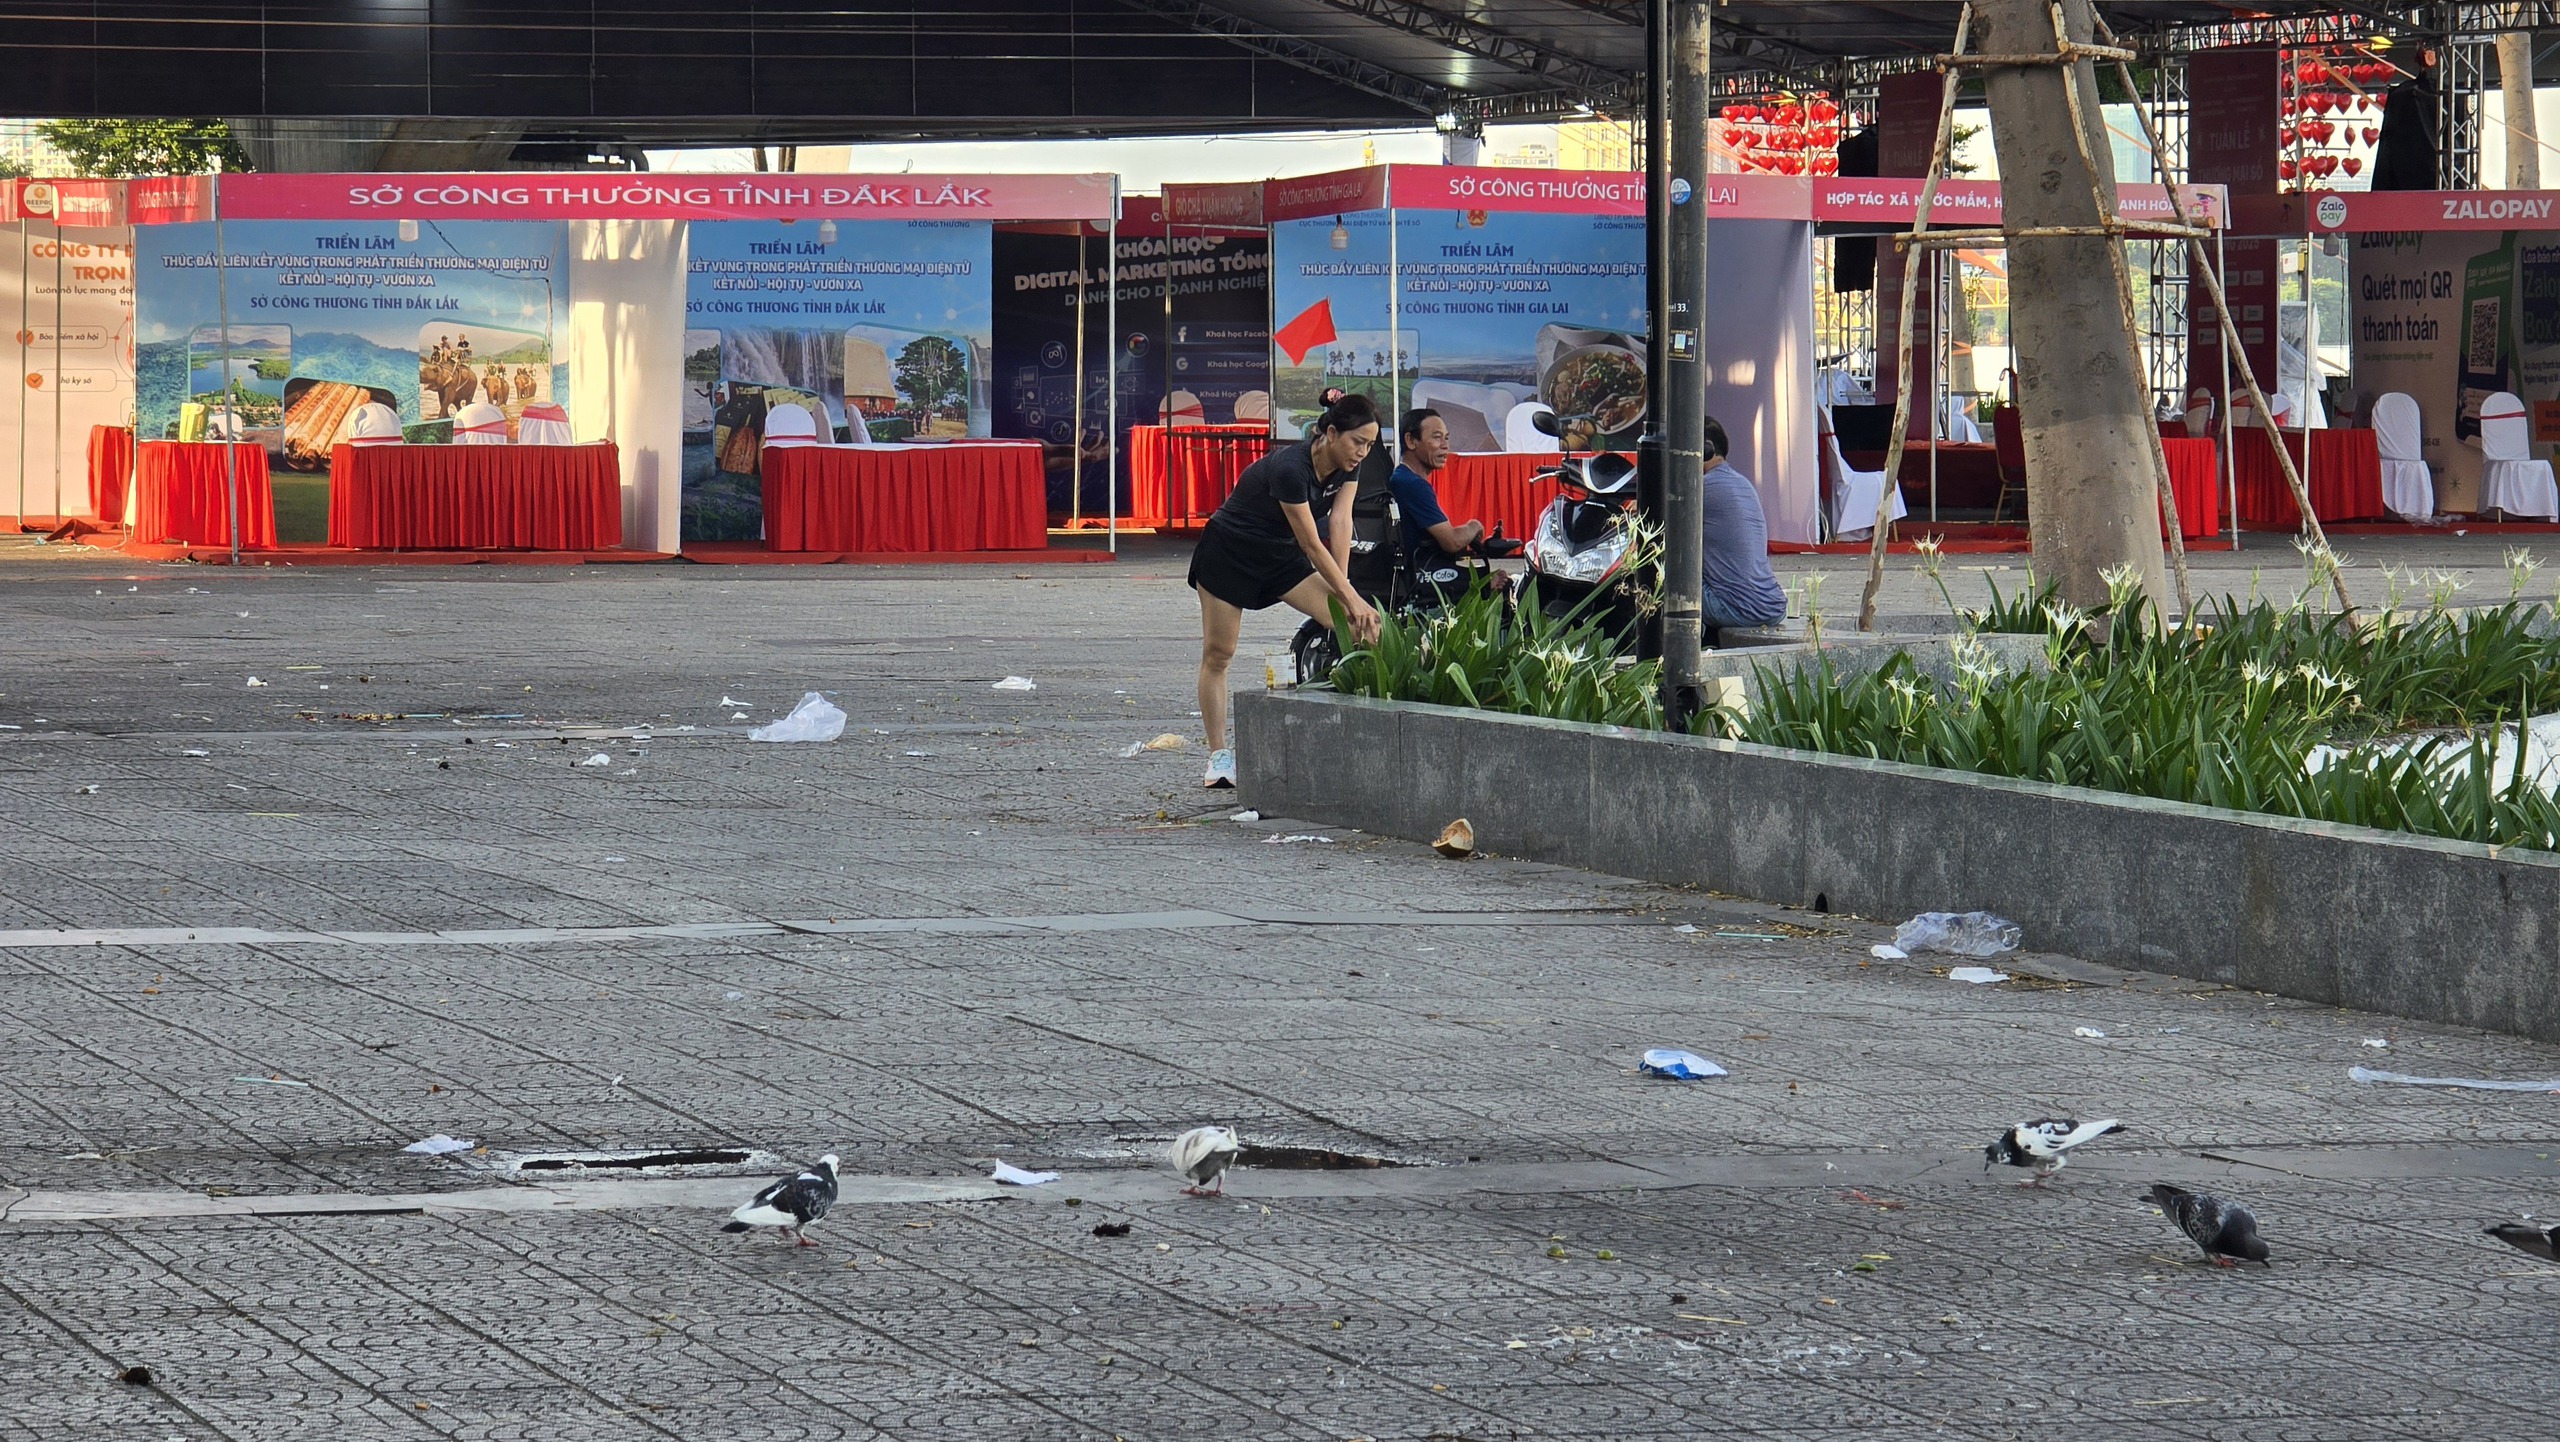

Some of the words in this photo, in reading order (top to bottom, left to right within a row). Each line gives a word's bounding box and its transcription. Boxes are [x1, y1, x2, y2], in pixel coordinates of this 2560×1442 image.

[349, 184, 404, 205] SỞ
[413, 185, 529, 205] CÔNG
[719, 183, 810, 205] TỈNH
[820, 183, 904, 205] ĐẮK
[915, 183, 987, 205] LẮK
[1449, 176, 1476, 195] SỞ
[1479, 178, 1534, 197] CÔNG
[1708, 187, 1738, 204] LAI
[1826, 192, 1855, 208] HỢP
[1857, 191, 1884, 205] TÁC
[1889, 191, 1909, 206] XÃ
[1914, 191, 1952, 207] NỚC
[2321, 201, 2345, 212] Zalo
[2320, 211, 2341, 223] pay
[2442, 199, 2553, 219] ZALOPAY
[33, 241, 91, 258] CÔNG
[98, 244, 116, 258] TY
[316, 232, 360, 249] TRIỂN
[749, 238, 792, 255] TRIỂN
[1441, 240, 1482, 257] TRIỂN
[162, 252, 194, 268] THÚC
[252, 250, 276, 268] KẾT
[277, 253, 310, 268] VÙNG
[312, 254, 353, 269] TRONG
[355, 253, 389, 269] PHÁT
[389, 251, 424, 269] TRIỂN
[427, 256, 476, 270] THƯƠNG
[502, 256, 530, 273] ĐIỆN
[531, 254, 549, 270] TỬ
[711, 258, 743, 274] VÙNG
[746, 260, 785, 274] TRONG
[787, 259, 818, 274] PHÁT
[819, 257, 853, 274] TRIỂN
[855, 261, 901, 275] THƯƠNG
[903, 262, 925, 277] MẠI
[927, 262, 953, 277] ĐIỆN
[955, 259, 971, 275] TỬ
[1300, 262, 1329, 276] THÚC
[1331, 261, 1355, 276] ĐẨY
[1355, 263, 1381, 276] LIÊN
[1382, 263, 1402, 276] KT
[1405, 262, 1436, 275] VÙNG
[1437, 263, 1475, 275] TRONG
[1477, 261, 1507, 275] PHÁT
[1507, 258, 1540, 275] TRIỂN
[1542, 262, 1587, 275] THƯƠNG
[1589, 263, 1610, 277] MẠI
[1612, 262, 1639, 277] ĐIỆN
[73, 266, 125, 284] TRỌN
[278, 269, 302, 286] KẾT
[303, 269, 325, 286] NỐI
[334, 272, 356, 288] HỘI
[357, 273, 373, 289] TỤ
[382, 273, 416, 287] VƯƠN
[417, 273, 435, 287] XA
[1014, 271, 1094, 291] DIGITAL
[1098, 257, 1216, 283] MARKETING
[90, 287, 117, 296] mang
[713, 274, 737, 291] KẾT
[737, 274, 758, 291] NỐI
[767, 277, 788, 292] HỘI
[789, 278, 805, 293] TỤ
[813, 277, 845, 291] VƯƠN
[846, 278, 863, 292] XA
[1115, 285, 1151, 301] CHO
[1217, 272, 1267, 291] NGHIỆ
[1406, 276, 1428, 292] KẾT
[1429, 276, 1450, 292] NỐI
[1458, 279, 1478, 294] HỘI
[1479, 280, 1495, 294] TỤ
[1502, 279, 1533, 293] VƯƠN
[1534, 280, 1551, 293] XA
[2362, 273, 2397, 301] Quét
[2400, 270, 2427, 306] mọi
[2430, 271, 2453, 299] QR
[251, 293, 269, 309] SỞ
[272, 294, 309, 309] CÔNG
[313, 297, 368, 309] THƯƠNG
[371, 294, 402, 309] TỈNH
[406, 294, 432, 310] ĐẮK
[436, 294, 459, 310] LẮK
[686, 298, 703, 313] SỞ
[706, 299, 743, 313] CÔNG
[749, 301, 800, 314] THƯƠNG
[803, 298, 832, 314] TỈNH
[835, 298, 860, 314] ĐẮK
[864, 298, 886, 314] LẮK
[1405, 300, 1440, 314] CÔNG
[1443, 302, 1494, 314] THƯƠNG
[1497, 300, 1525, 314] TỈNH
[1528, 302, 1549, 314] GIA
[1552, 302, 1569, 314] LAI
[1244, 330, 1268, 338] Faceb
[2362, 314, 2403, 342] thanh
[2406, 312, 2439, 341] toán
[1245, 360, 1268, 369] Googl
